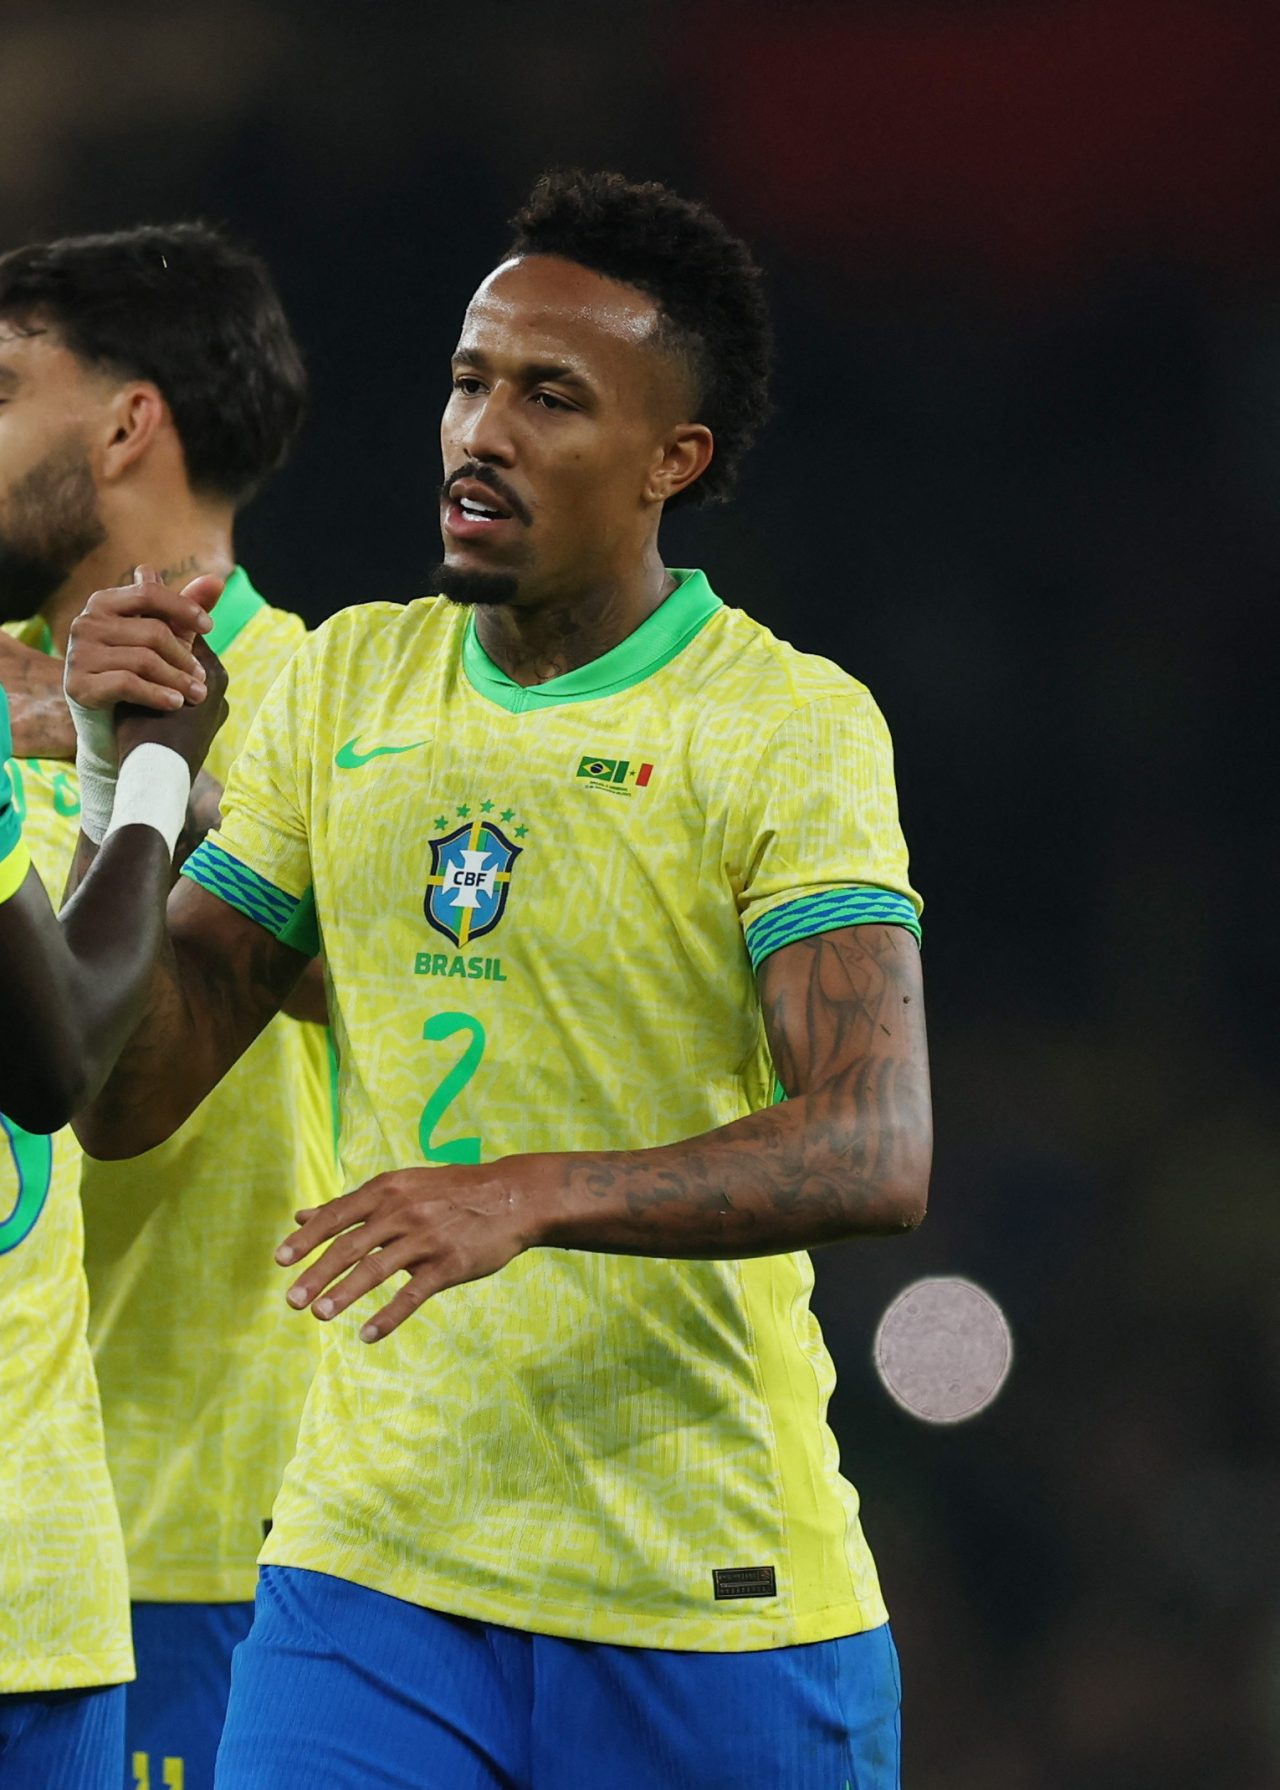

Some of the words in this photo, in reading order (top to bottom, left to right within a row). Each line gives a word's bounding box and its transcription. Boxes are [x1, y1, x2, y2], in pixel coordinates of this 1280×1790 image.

[453, 871, 487, 887] CBF
[414, 952, 507, 981] BRASIL
[418, 1011, 486, 1165] 2
